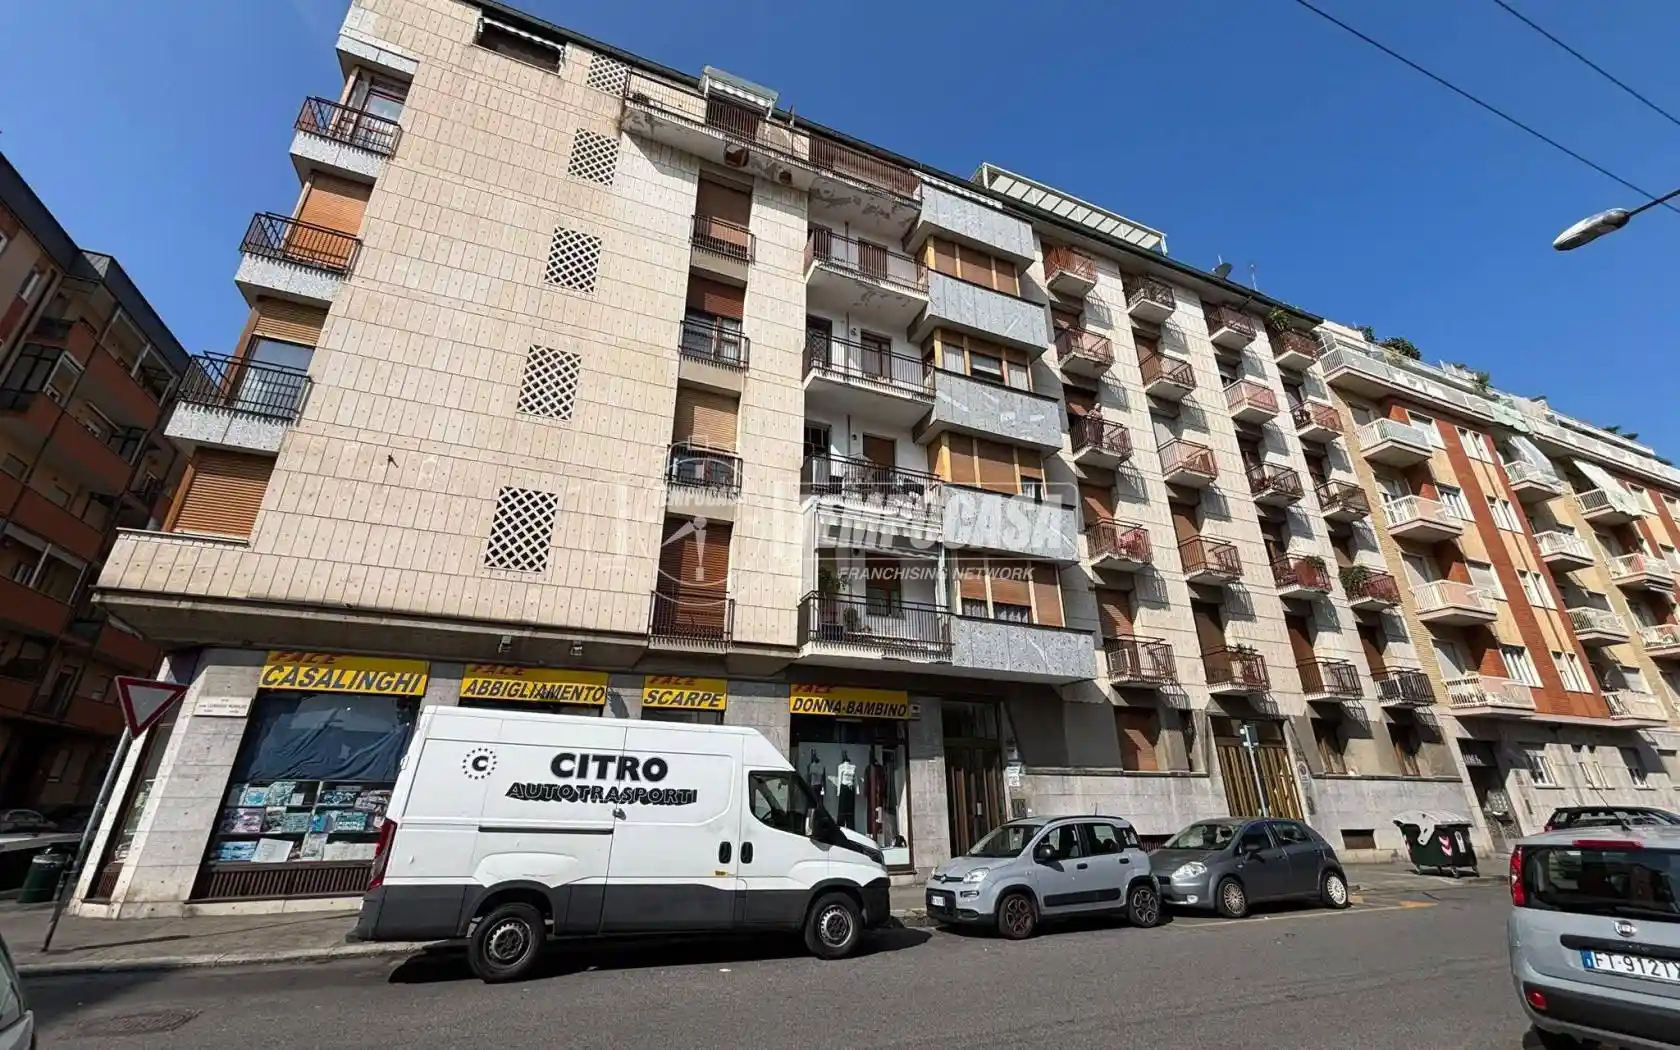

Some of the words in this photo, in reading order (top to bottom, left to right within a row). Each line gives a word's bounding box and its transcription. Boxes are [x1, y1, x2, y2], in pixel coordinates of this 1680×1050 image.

[261, 664, 422, 693] CASALINGHI
[463, 679, 605, 702] ABBIGLIAMENTO
[643, 689, 724, 707] SCARPE
[791, 697, 907, 717] DONNA-BAMBINO
[550, 752, 669, 782] CITRO
[504, 782, 698, 806] AUTOTRASPORTI
